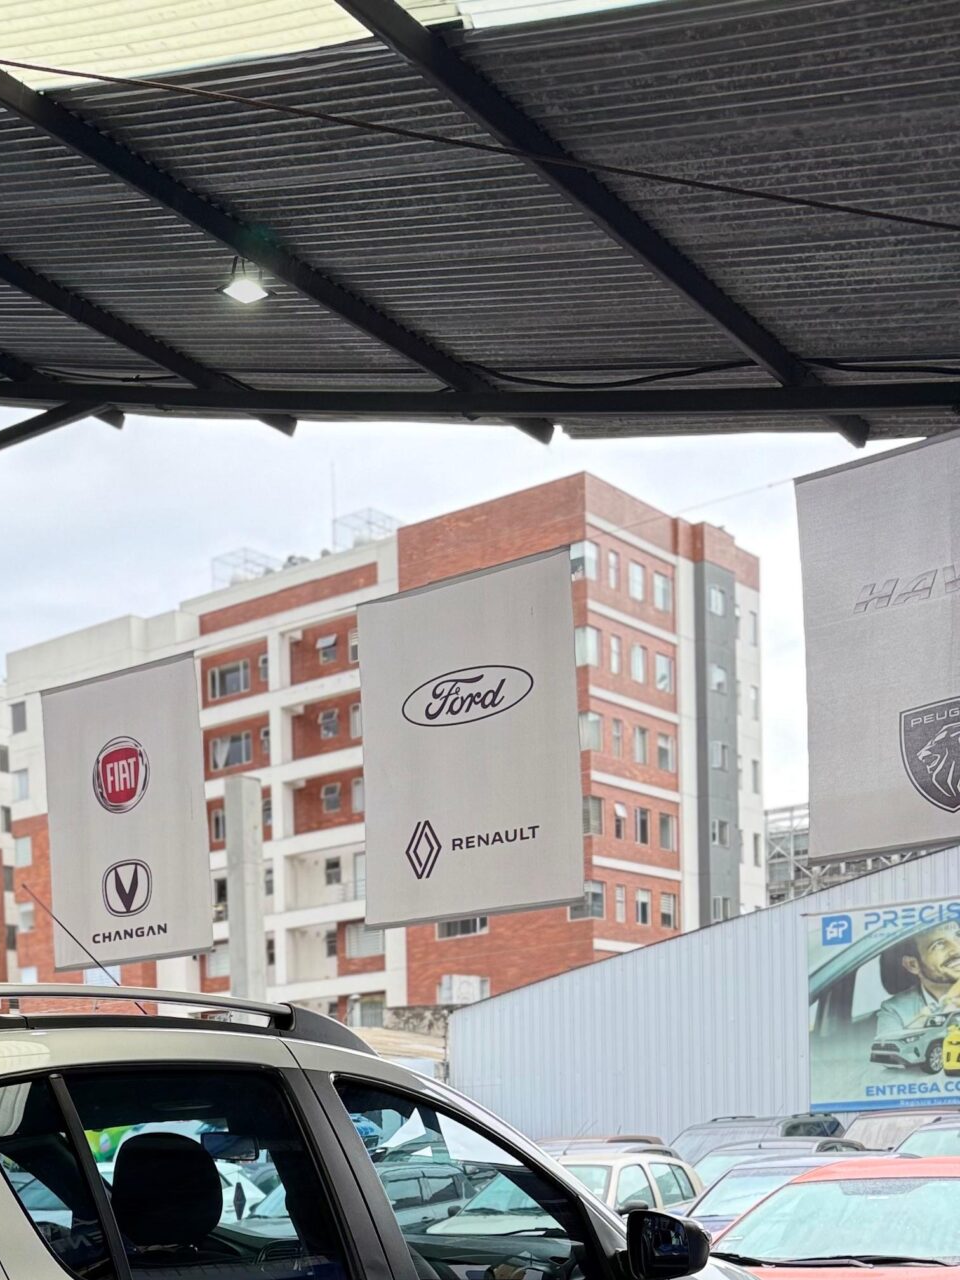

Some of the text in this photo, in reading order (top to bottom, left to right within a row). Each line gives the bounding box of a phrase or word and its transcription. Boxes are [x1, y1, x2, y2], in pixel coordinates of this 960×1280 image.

[424, 673, 507, 721] Ford
[105, 757, 137, 792] FIAT
[452, 825, 541, 851] RENAULT
[91, 922, 168, 944] CHANGAN
[865, 1082, 941, 1096] ENTREGA
